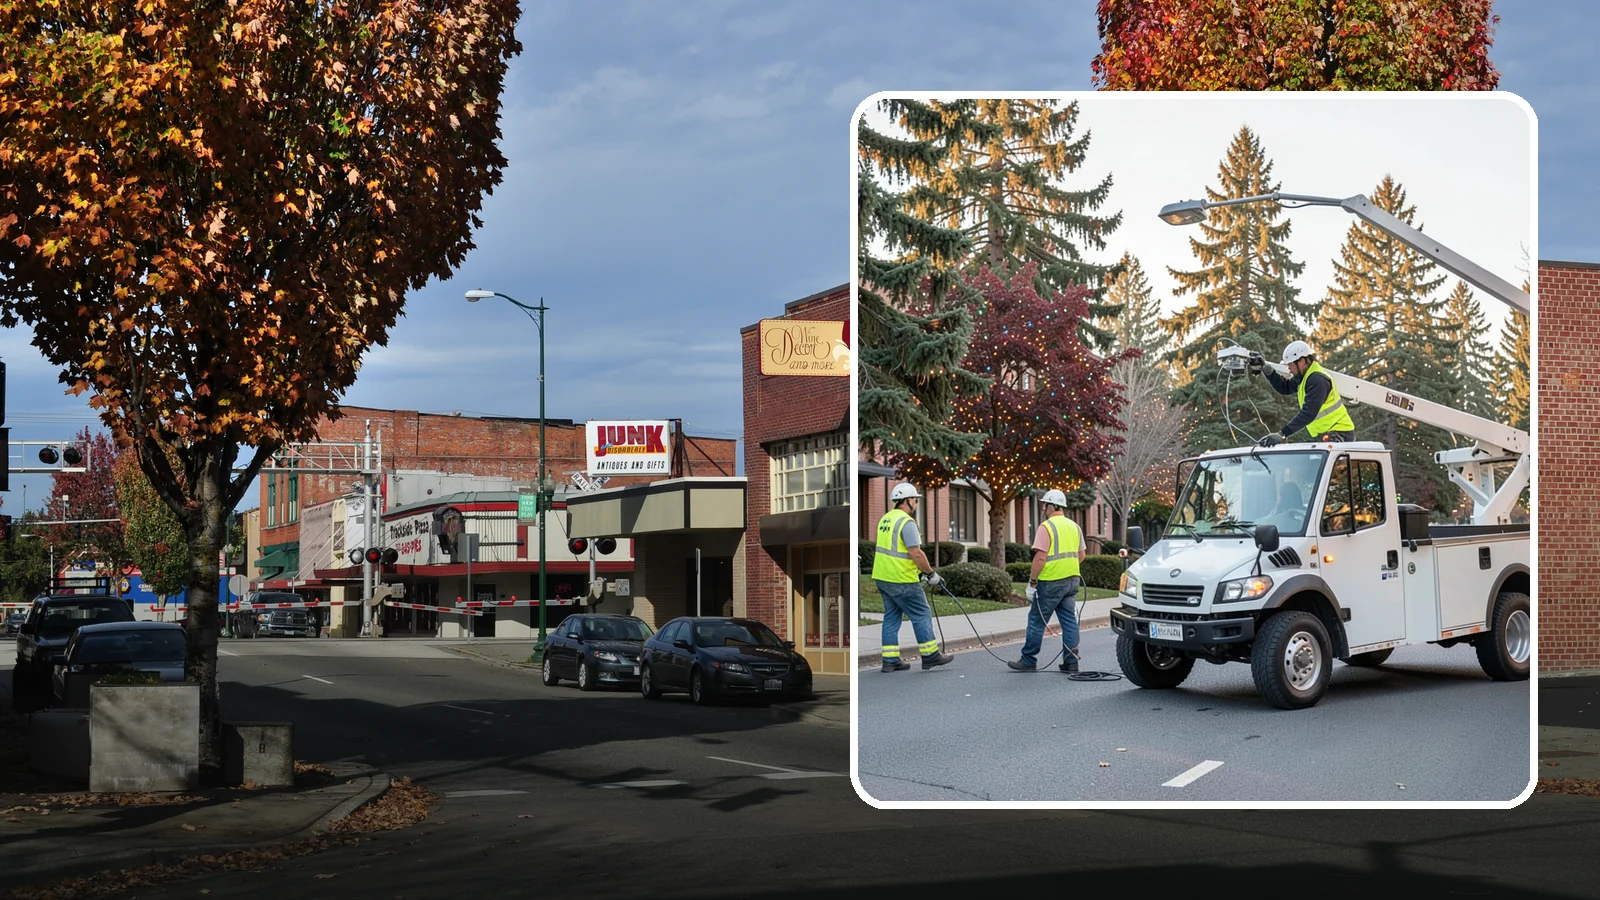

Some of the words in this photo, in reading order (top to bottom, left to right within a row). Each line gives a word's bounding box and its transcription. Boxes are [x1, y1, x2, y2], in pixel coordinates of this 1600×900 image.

[595, 425, 665, 457] JUNK
[607, 446, 645, 454] DISORDERLY
[597, 461, 628, 470] ANTIQUES
[631, 461, 643, 469] AND
[647, 461, 665, 469] GIFTS
[390, 524, 413, 539] Trackside
[414, 520, 429, 534] Pizza
